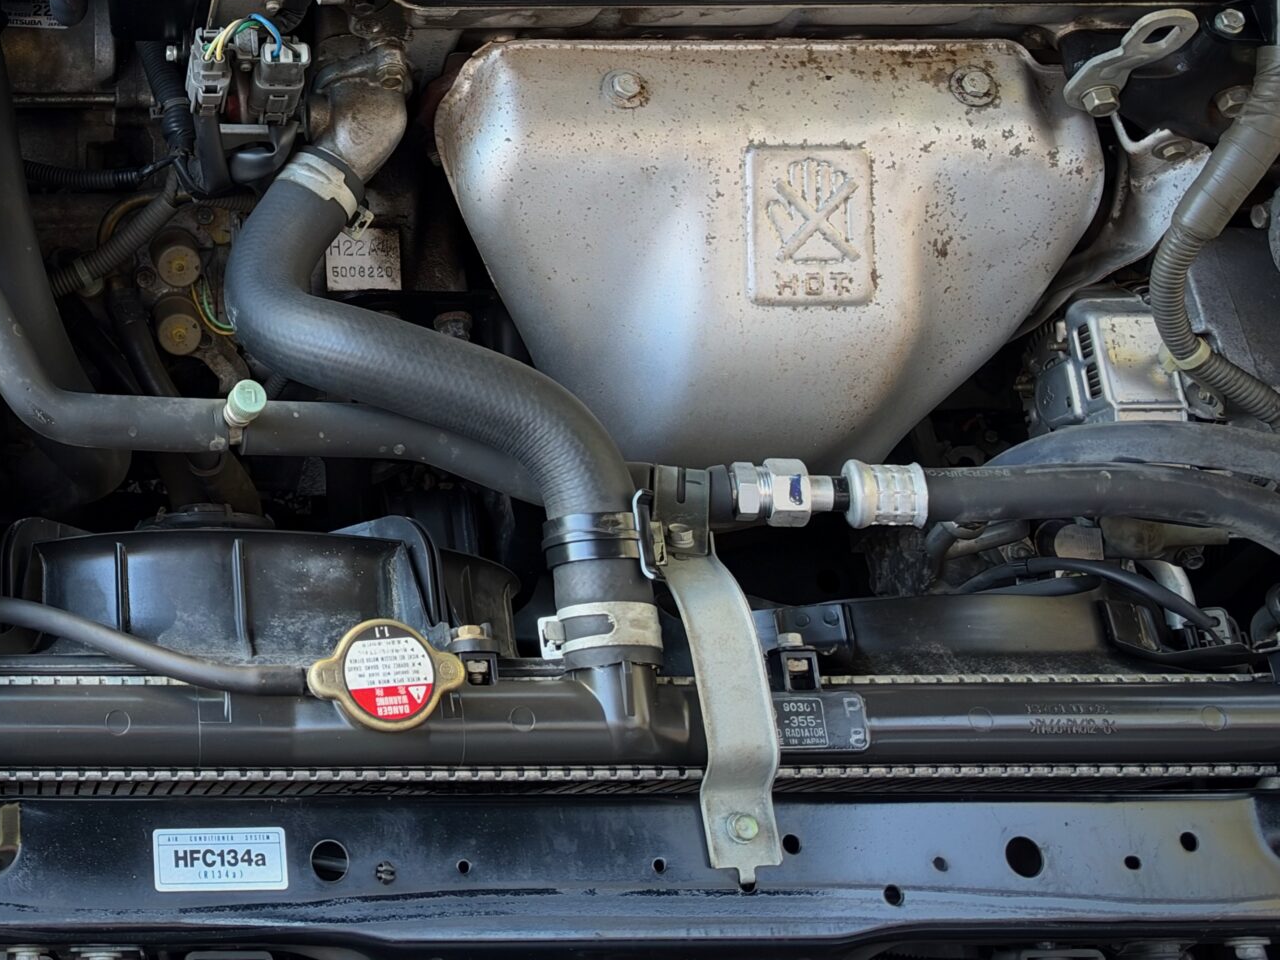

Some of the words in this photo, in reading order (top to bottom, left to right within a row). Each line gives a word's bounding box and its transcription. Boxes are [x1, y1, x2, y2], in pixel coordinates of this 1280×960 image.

[775, 271, 856, 297] HOT
[374, 626, 389, 637] 1.1
[375, 694, 408, 705] WARNUNG
[376, 704, 410, 715] DANGER
[785, 727, 825, 738] RADIATOR
[173, 848, 266, 869] HFC134a
[198, 870, 243, 879] (R134a)
